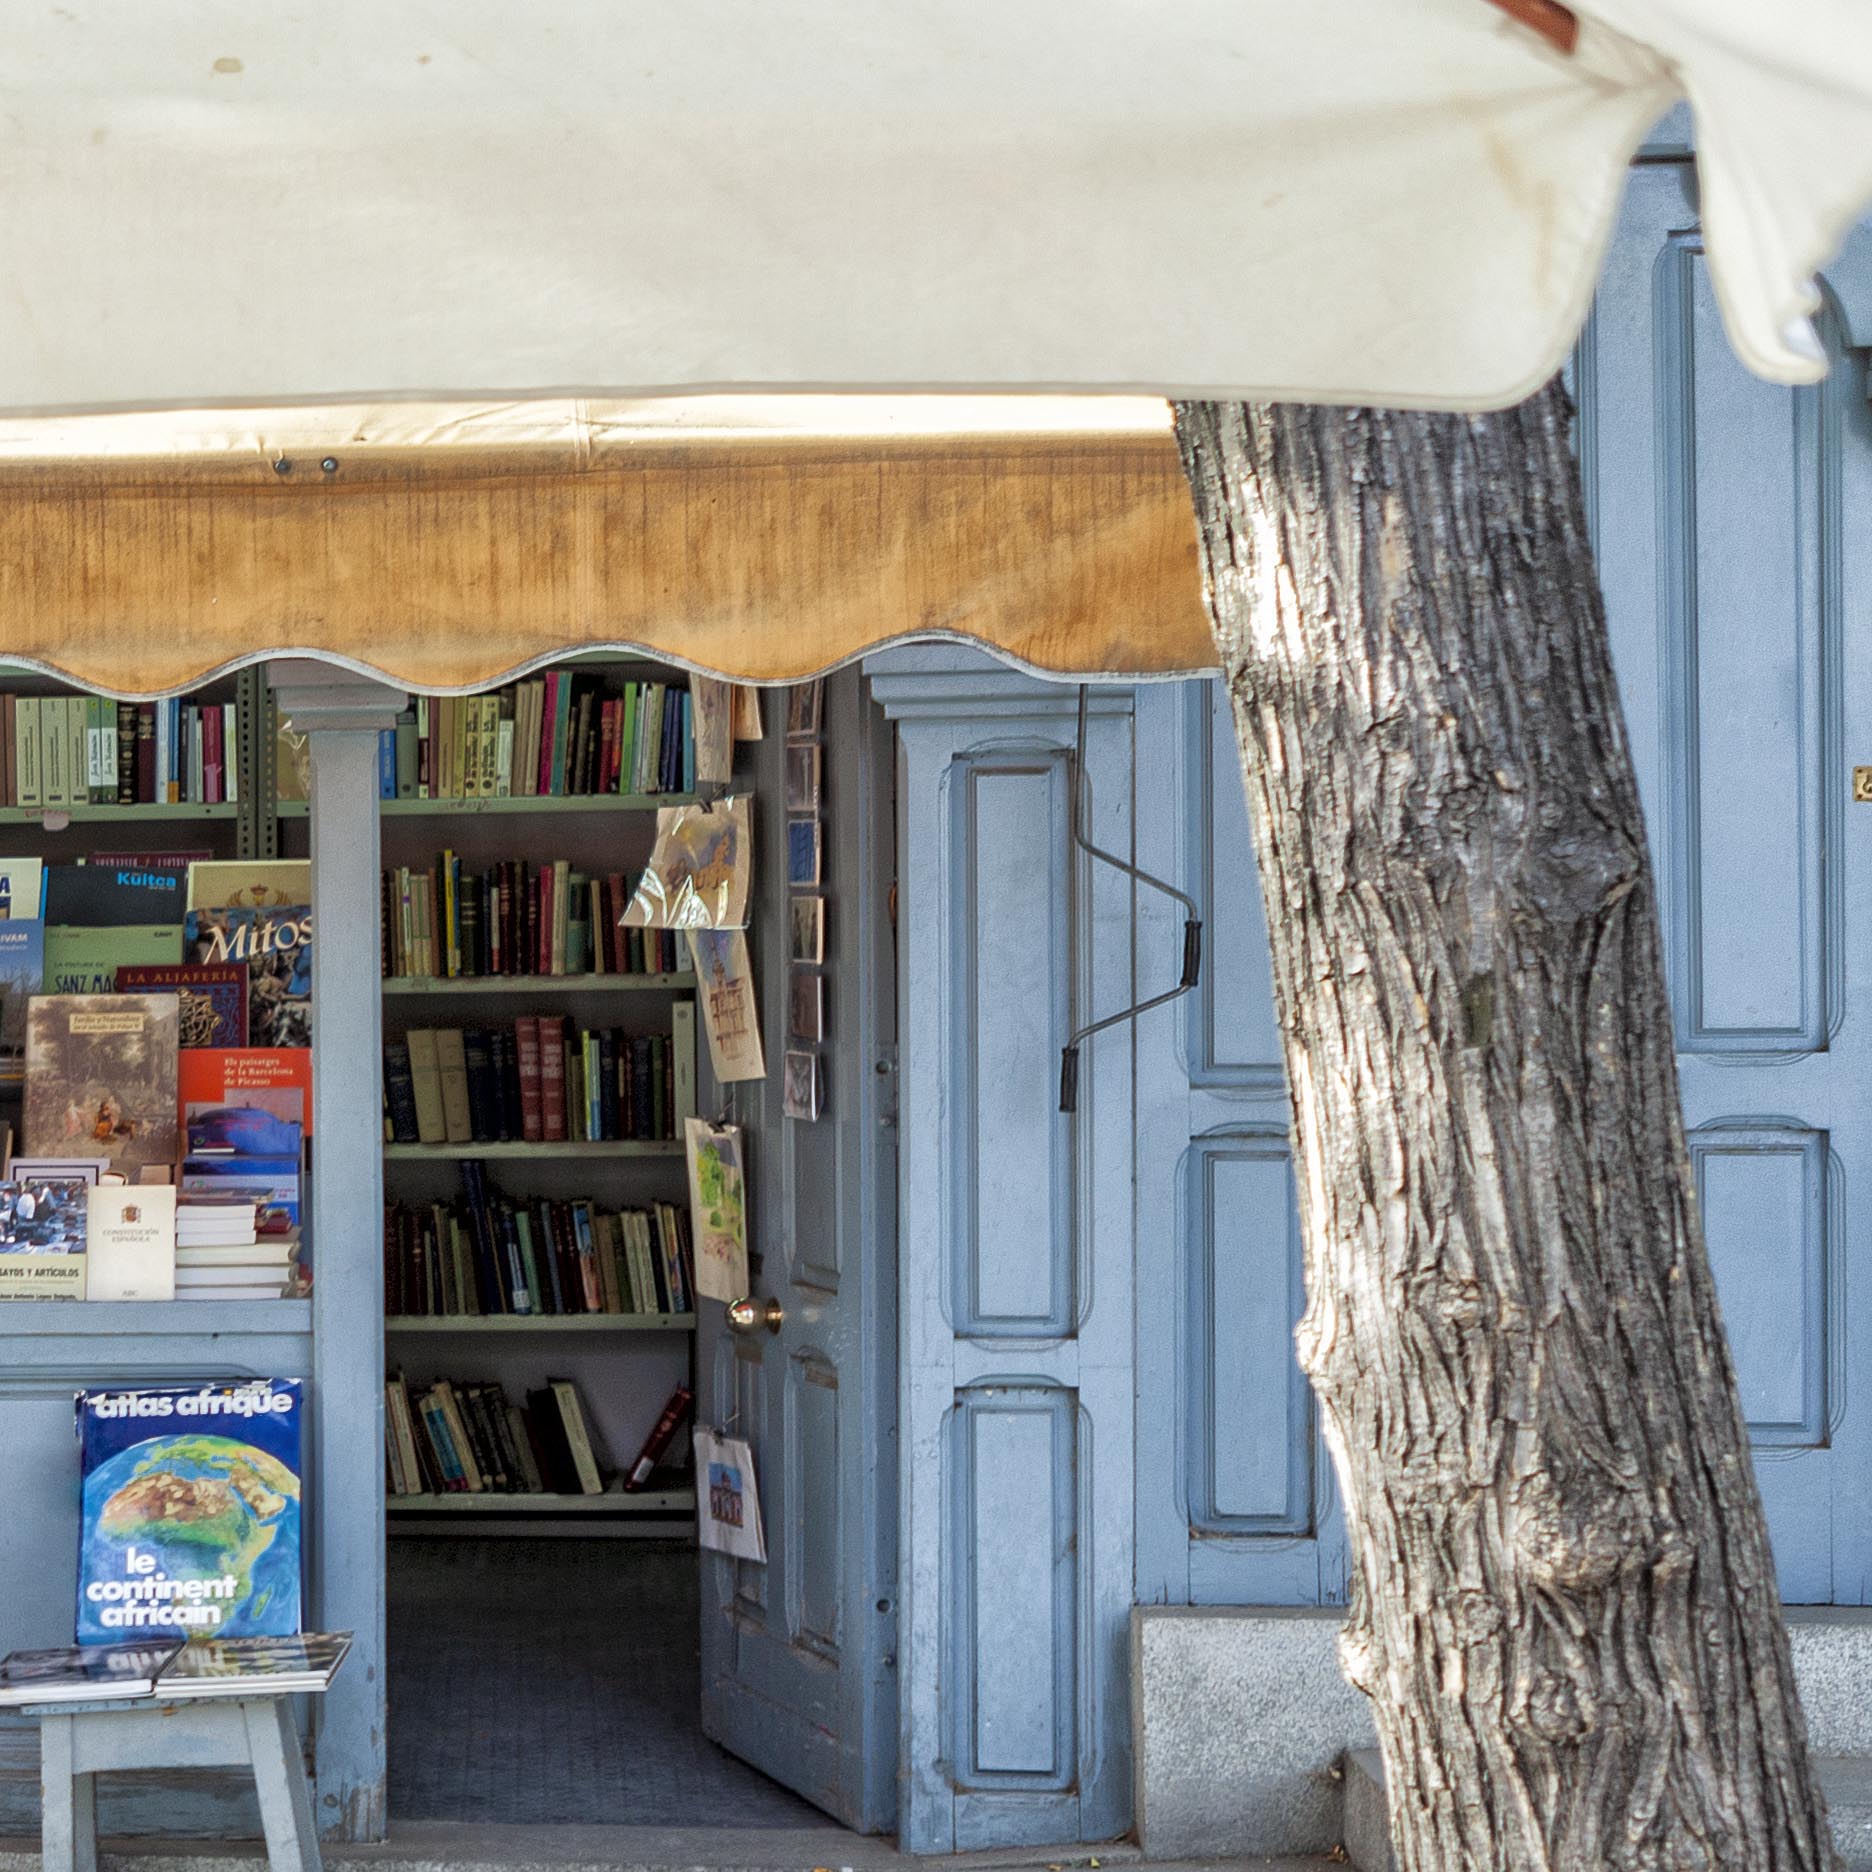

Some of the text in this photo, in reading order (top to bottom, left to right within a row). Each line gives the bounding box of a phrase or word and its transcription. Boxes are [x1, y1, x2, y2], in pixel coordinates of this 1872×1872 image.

[0, 933, 28, 943] IVAM
[209, 915, 312, 965] Mitos
[55, 973, 88, 994] SANZ
[127, 972, 145, 984] LA
[27, 1267, 32, 1278] Y
[34, 1266, 79, 1278] ARTÍCULOS
[94, 1387, 293, 1420] atlas afrique
[126, 1546, 156, 1575] le
[86, 1573, 239, 1602] continent
[99, 1599, 222, 1628] africain
